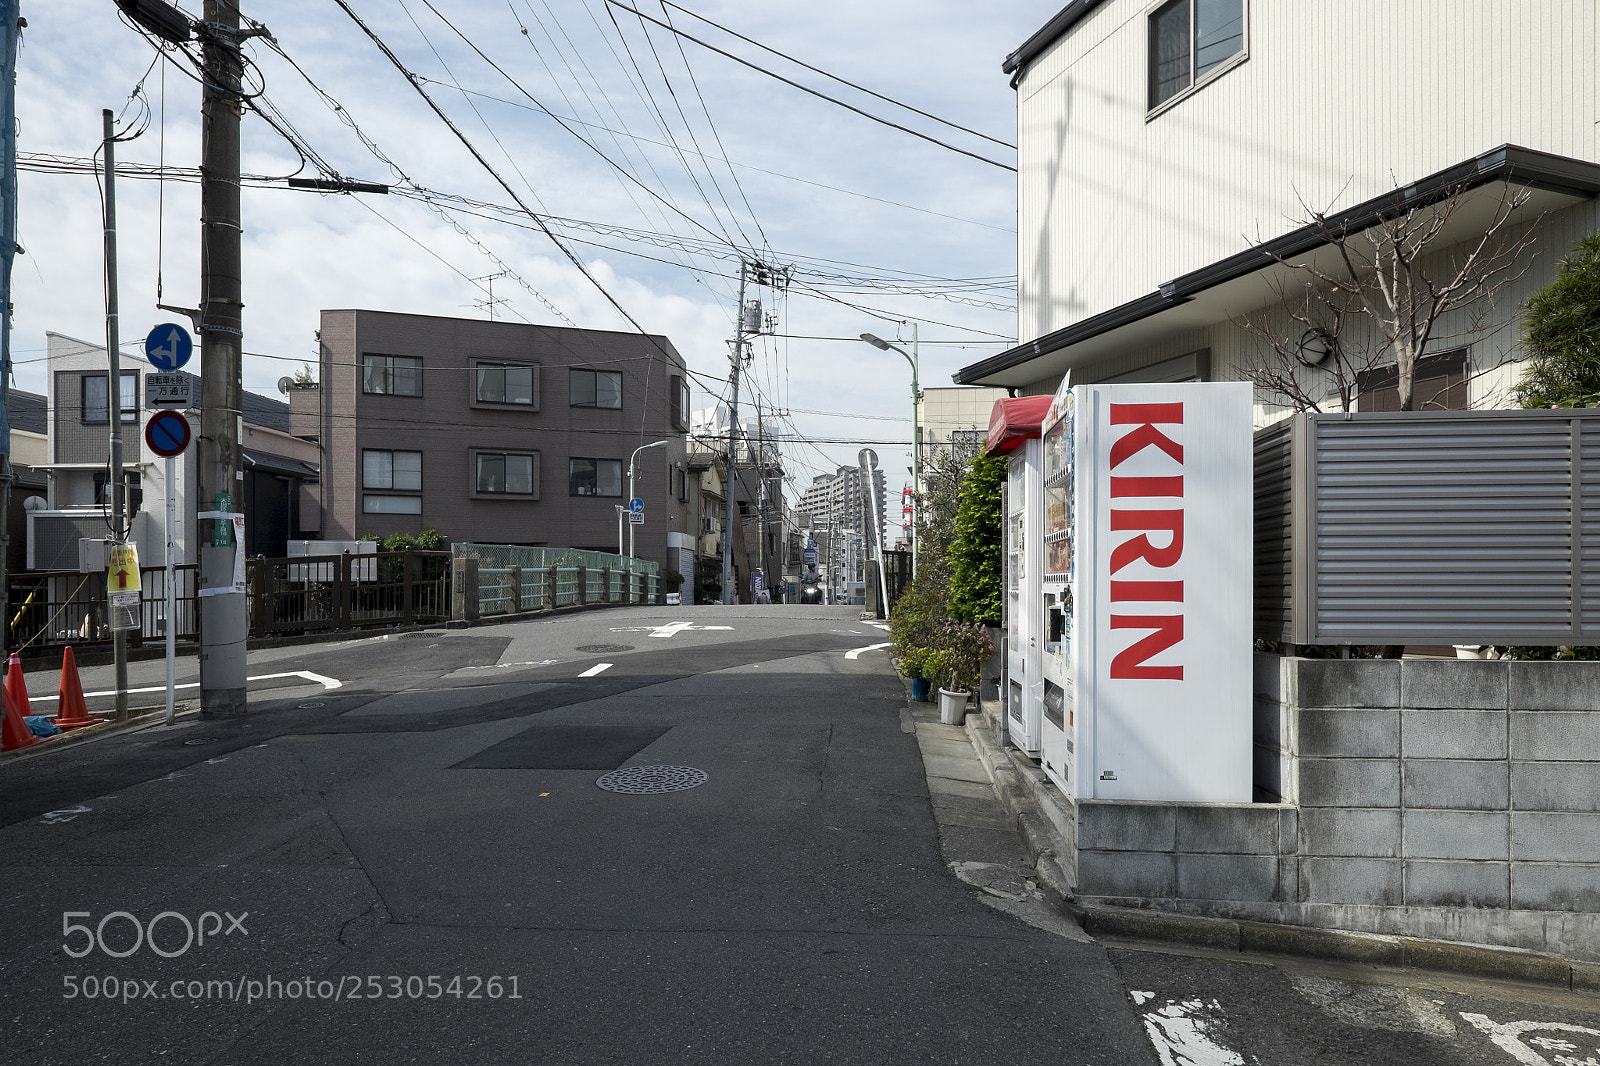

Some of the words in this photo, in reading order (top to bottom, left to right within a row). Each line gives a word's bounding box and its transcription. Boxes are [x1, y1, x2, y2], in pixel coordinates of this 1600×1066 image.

[148, 375, 189, 384] 自転車を除く
[148, 387, 189, 396] 一方通行
[1110, 402, 1184, 680] KIRIN
